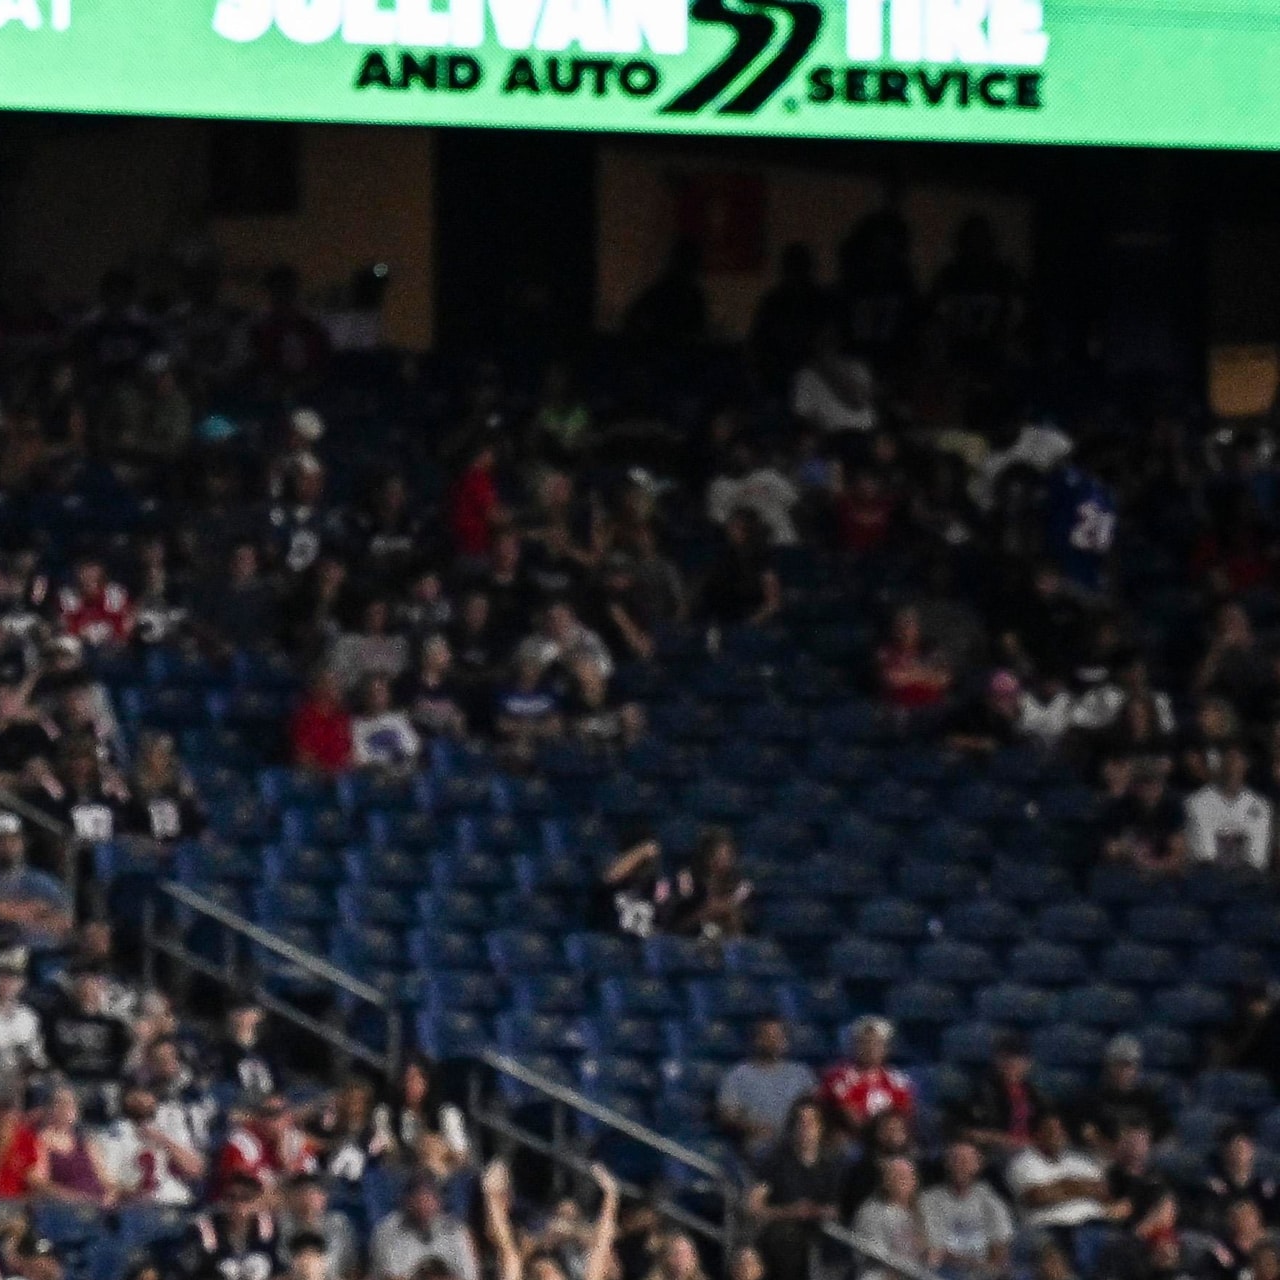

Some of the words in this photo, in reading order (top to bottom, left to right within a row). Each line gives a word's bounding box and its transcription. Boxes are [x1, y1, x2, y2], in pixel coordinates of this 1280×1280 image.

[354, 50, 482, 91] AND
[504, 55, 661, 98] AUTO
[808, 66, 1044, 109] SERVICE
